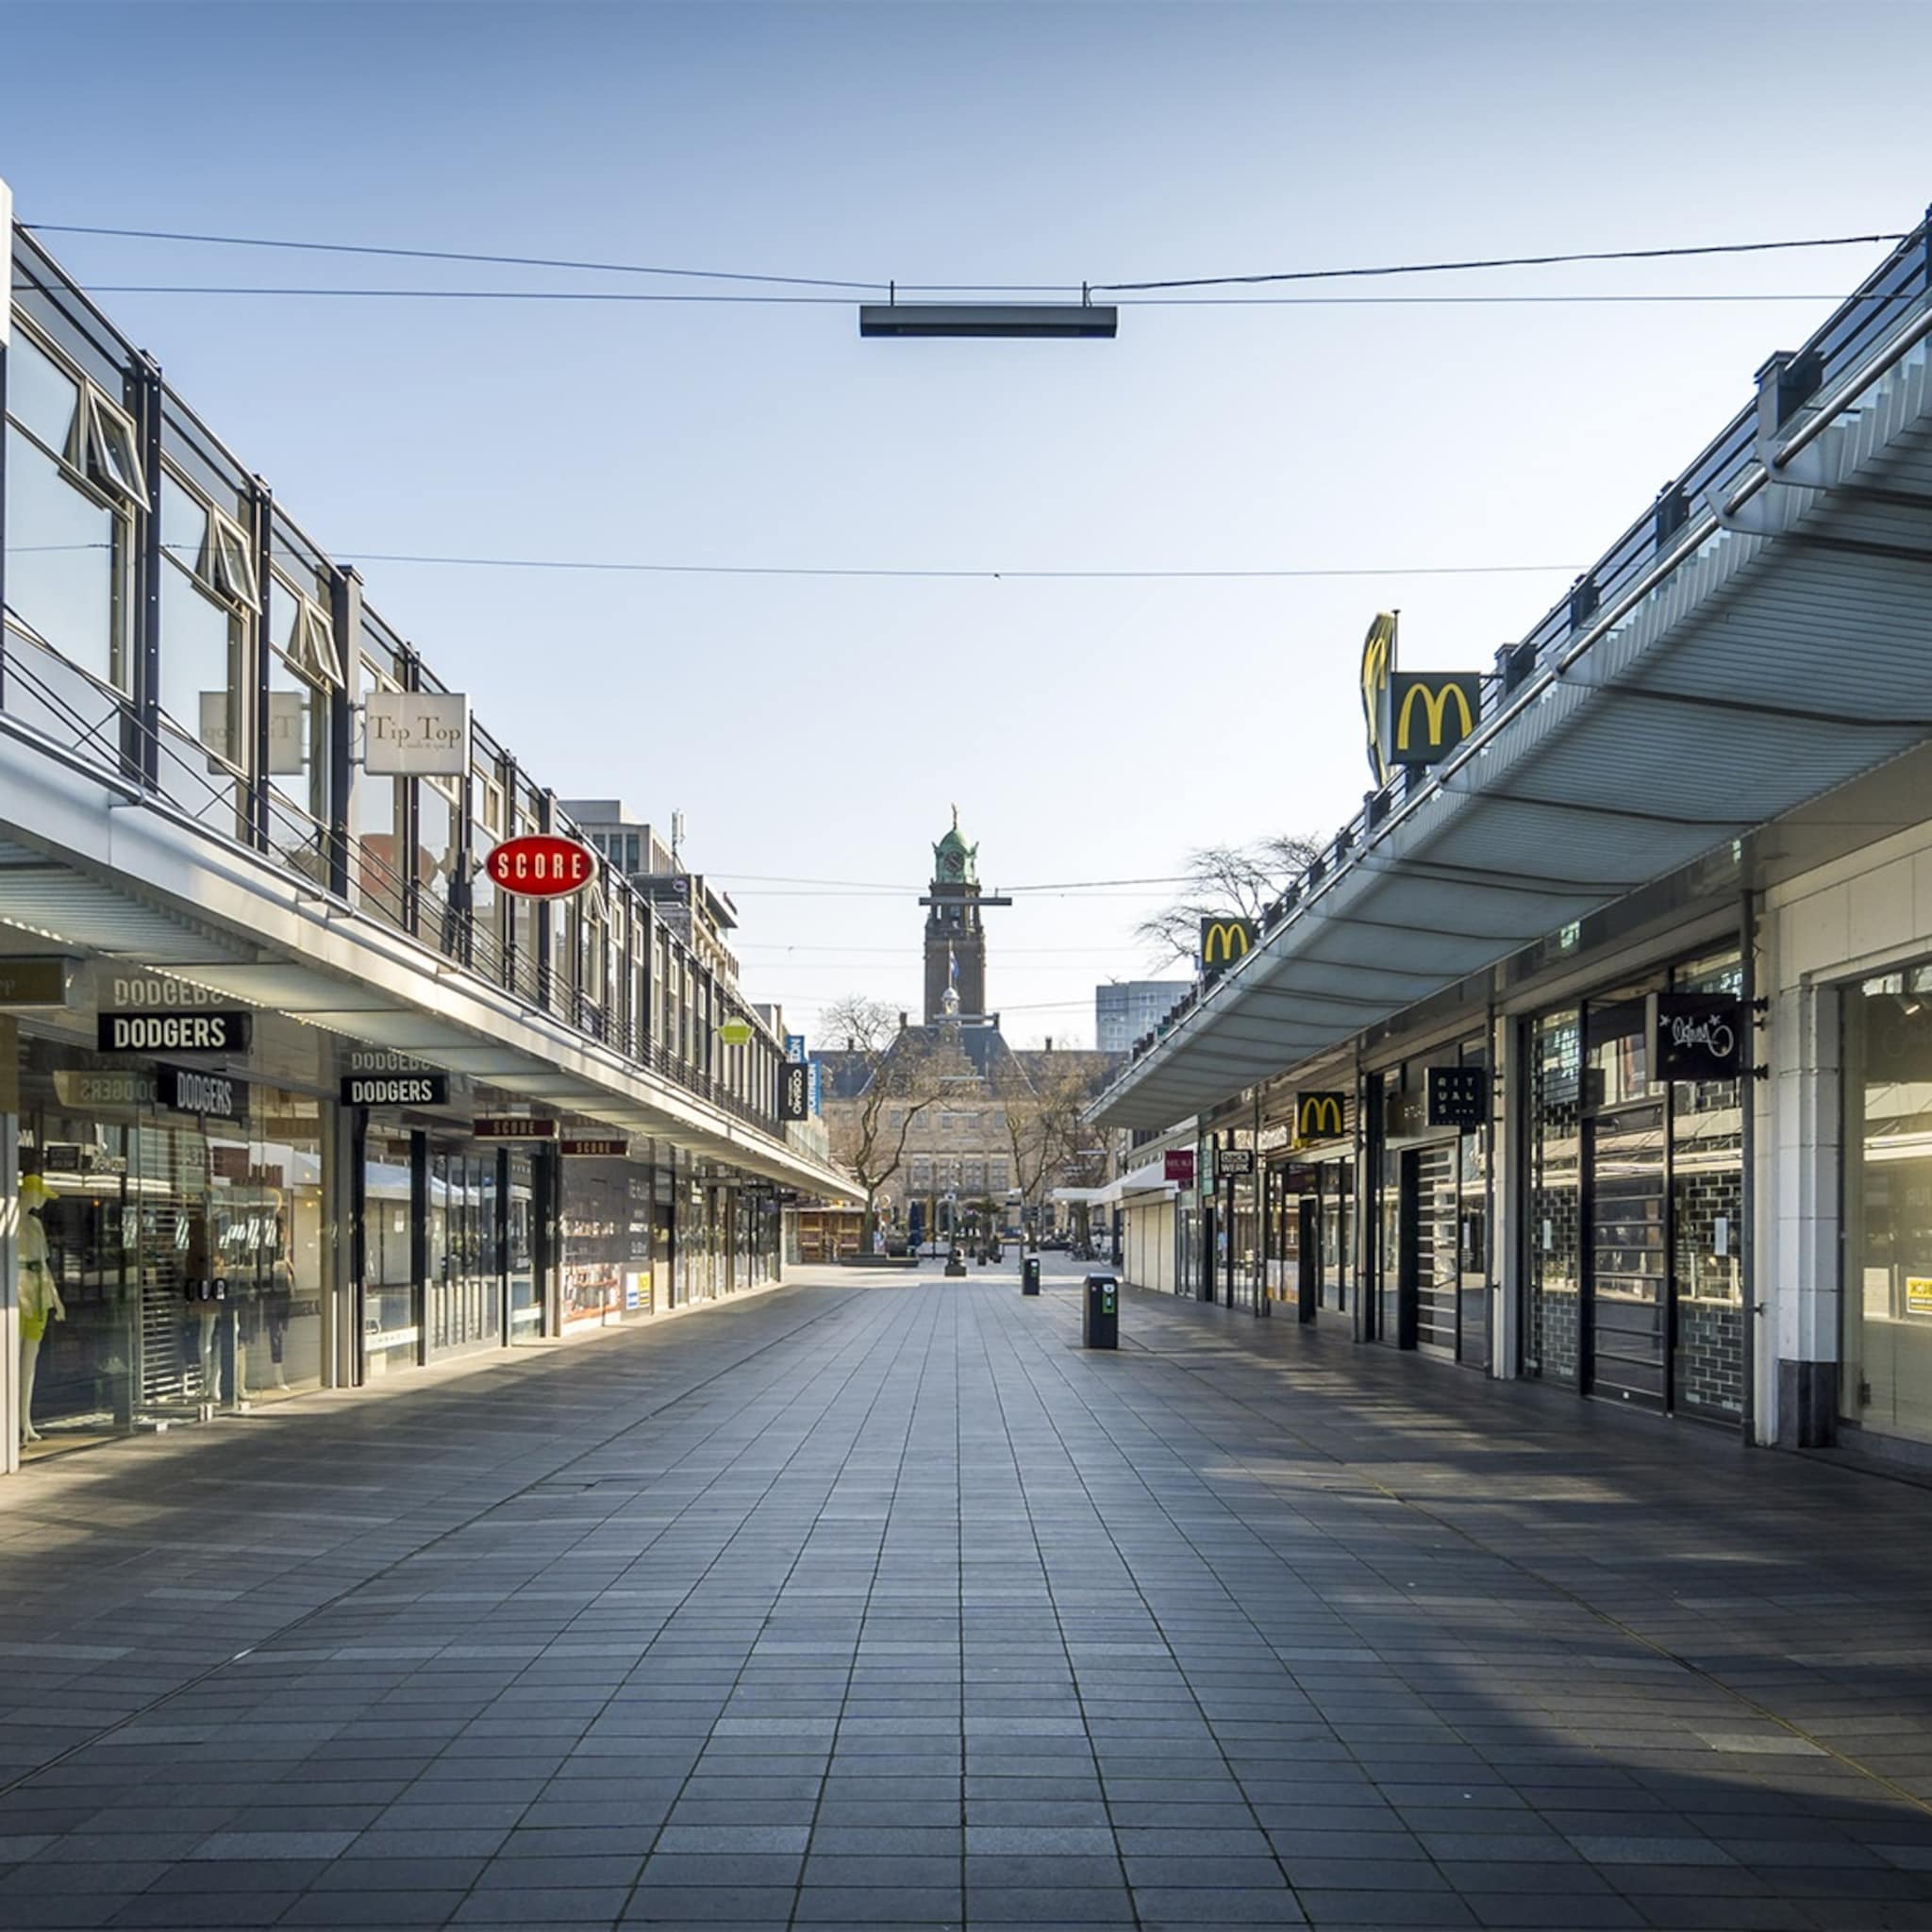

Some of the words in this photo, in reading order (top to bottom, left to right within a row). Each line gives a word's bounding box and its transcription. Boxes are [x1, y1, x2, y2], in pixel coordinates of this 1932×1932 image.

[370, 716, 409, 747] Tip
[417, 716, 461, 748] Top
[497, 852, 582, 879] SCORE
[114, 1018, 225, 1047] DODGERS
[177, 1072, 232, 1115] DODGERS
[352, 1079, 432, 1103] DODGERS
[792, 1069, 802, 1114] COSMO
[493, 1121, 535, 1135] SCORE
[576, 1141, 610, 1154] SCORE
